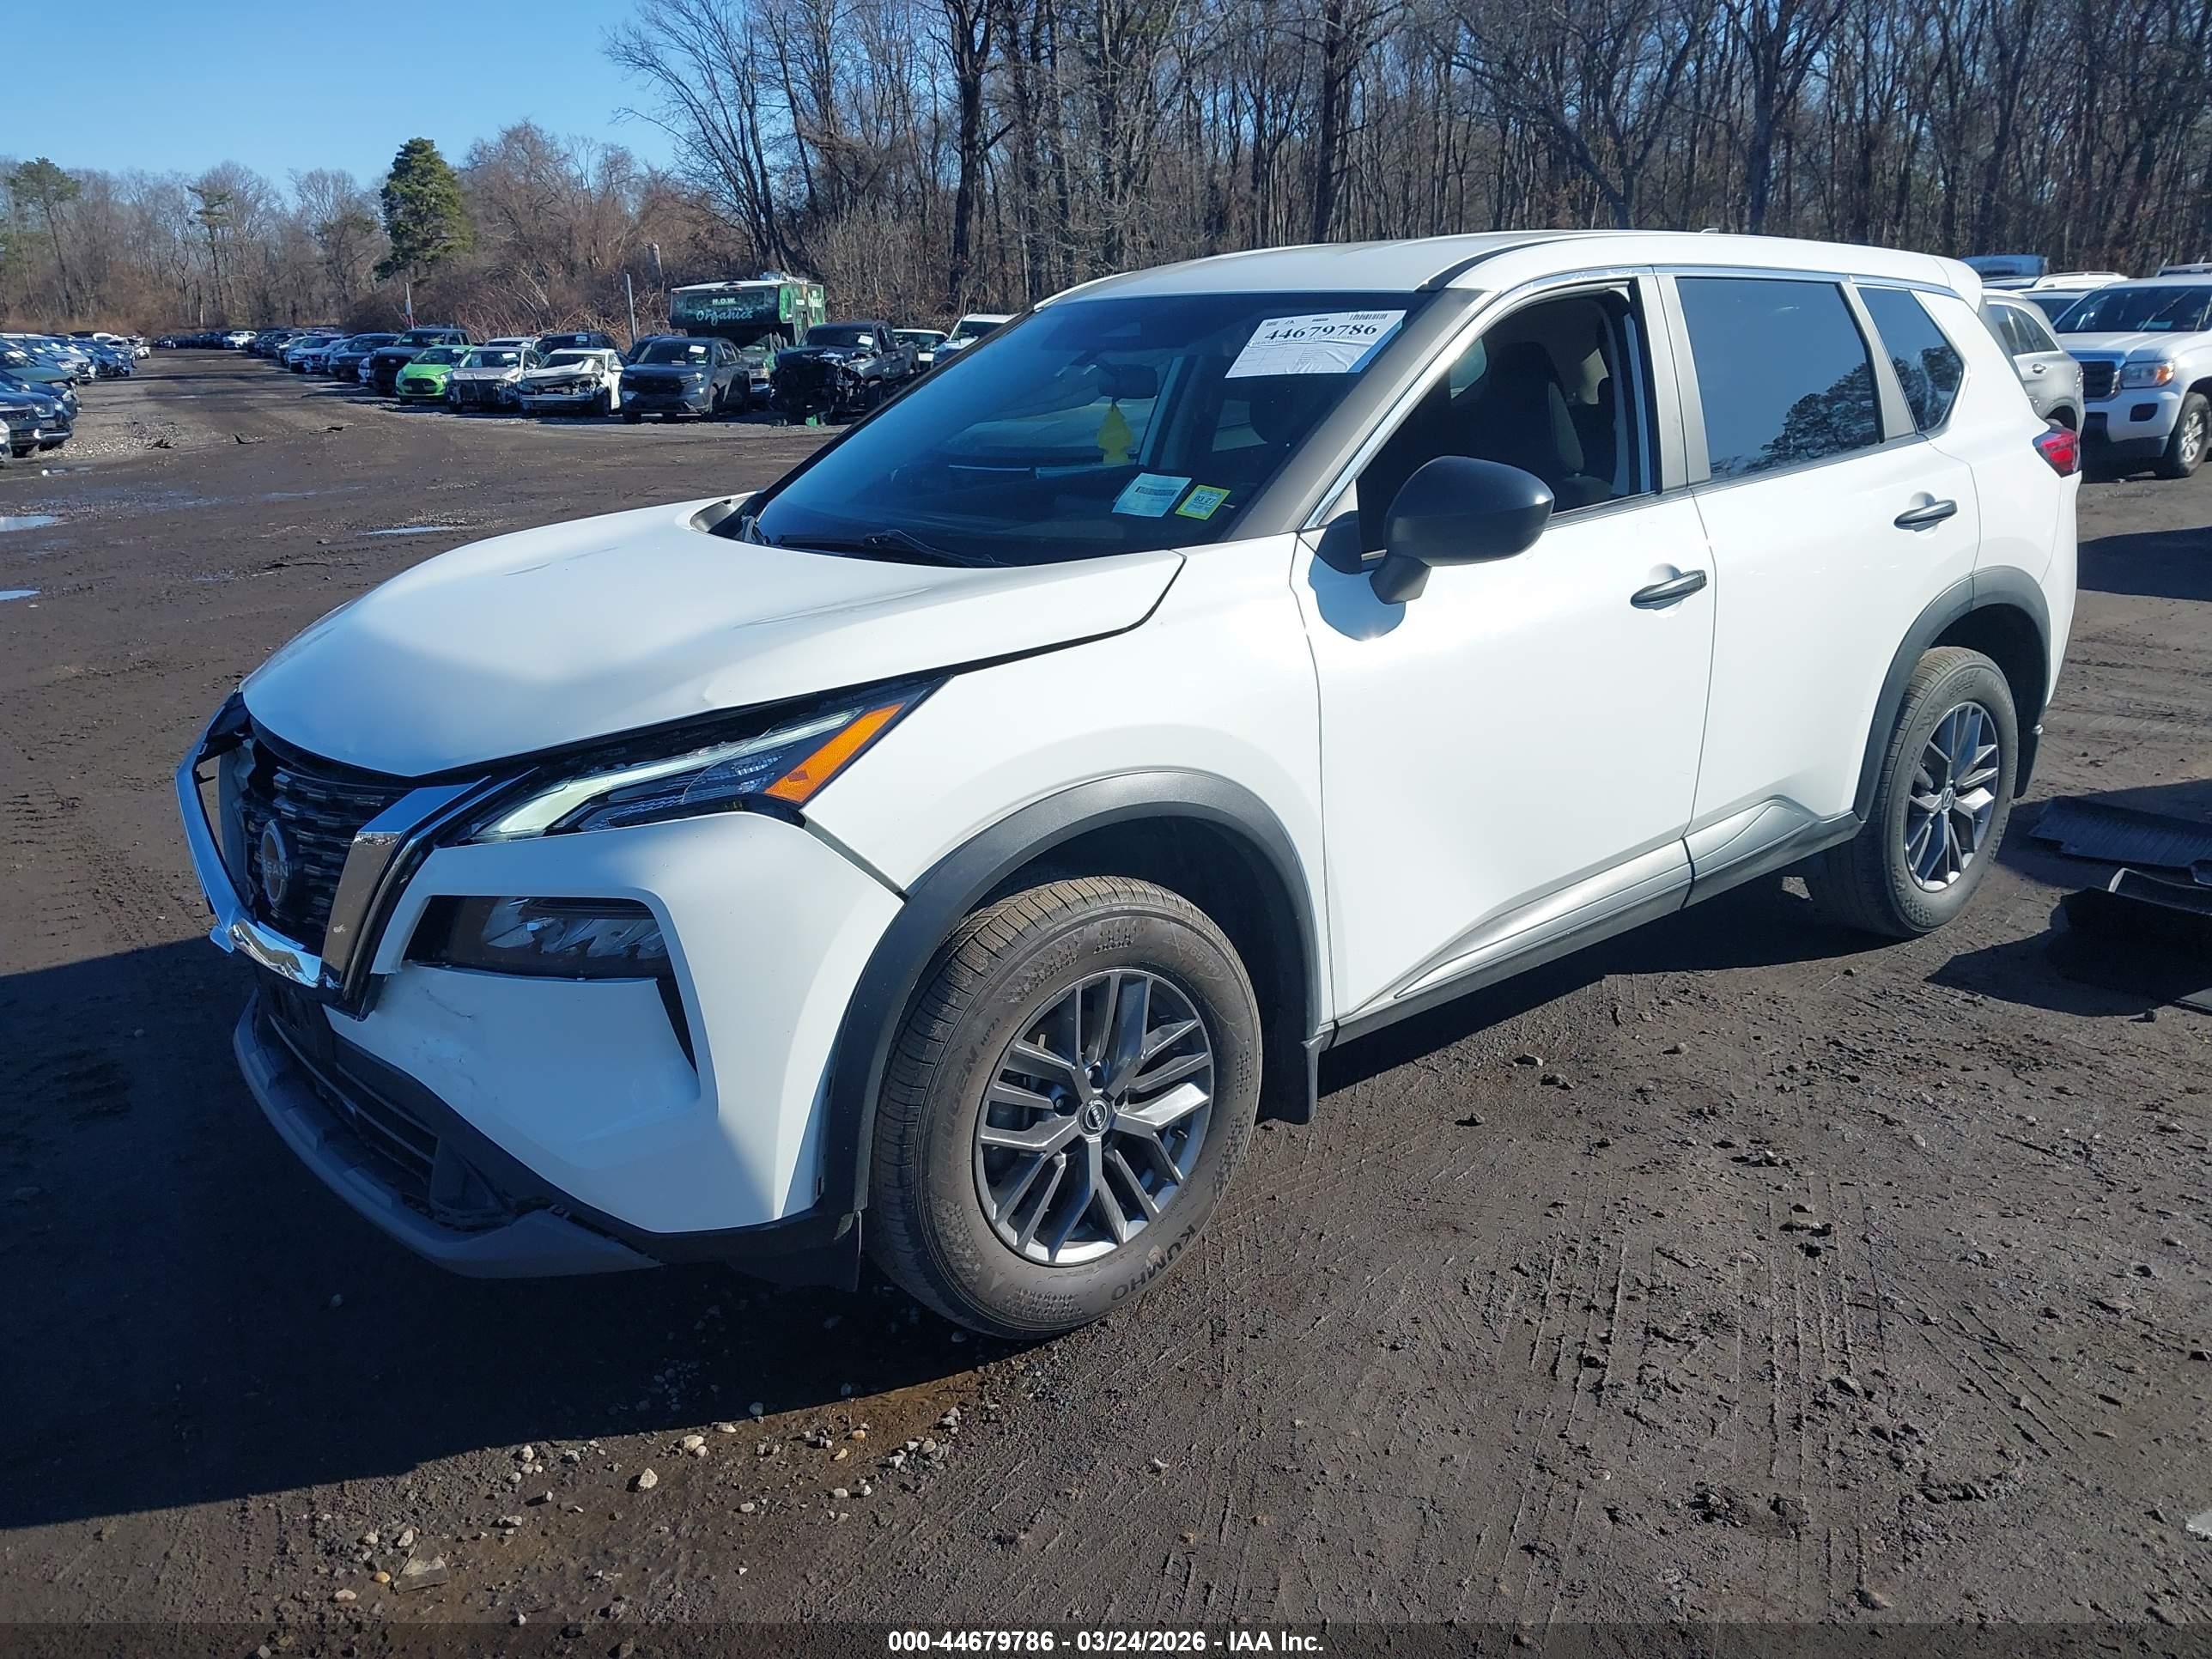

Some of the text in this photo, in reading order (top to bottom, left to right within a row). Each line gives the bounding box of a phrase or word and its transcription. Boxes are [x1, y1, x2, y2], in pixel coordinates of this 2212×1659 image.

[696, 309, 753, 326] Organics
[1264, 324, 1377, 340] 44679786
[1111, 1224, 1196, 1301] KUMHO
